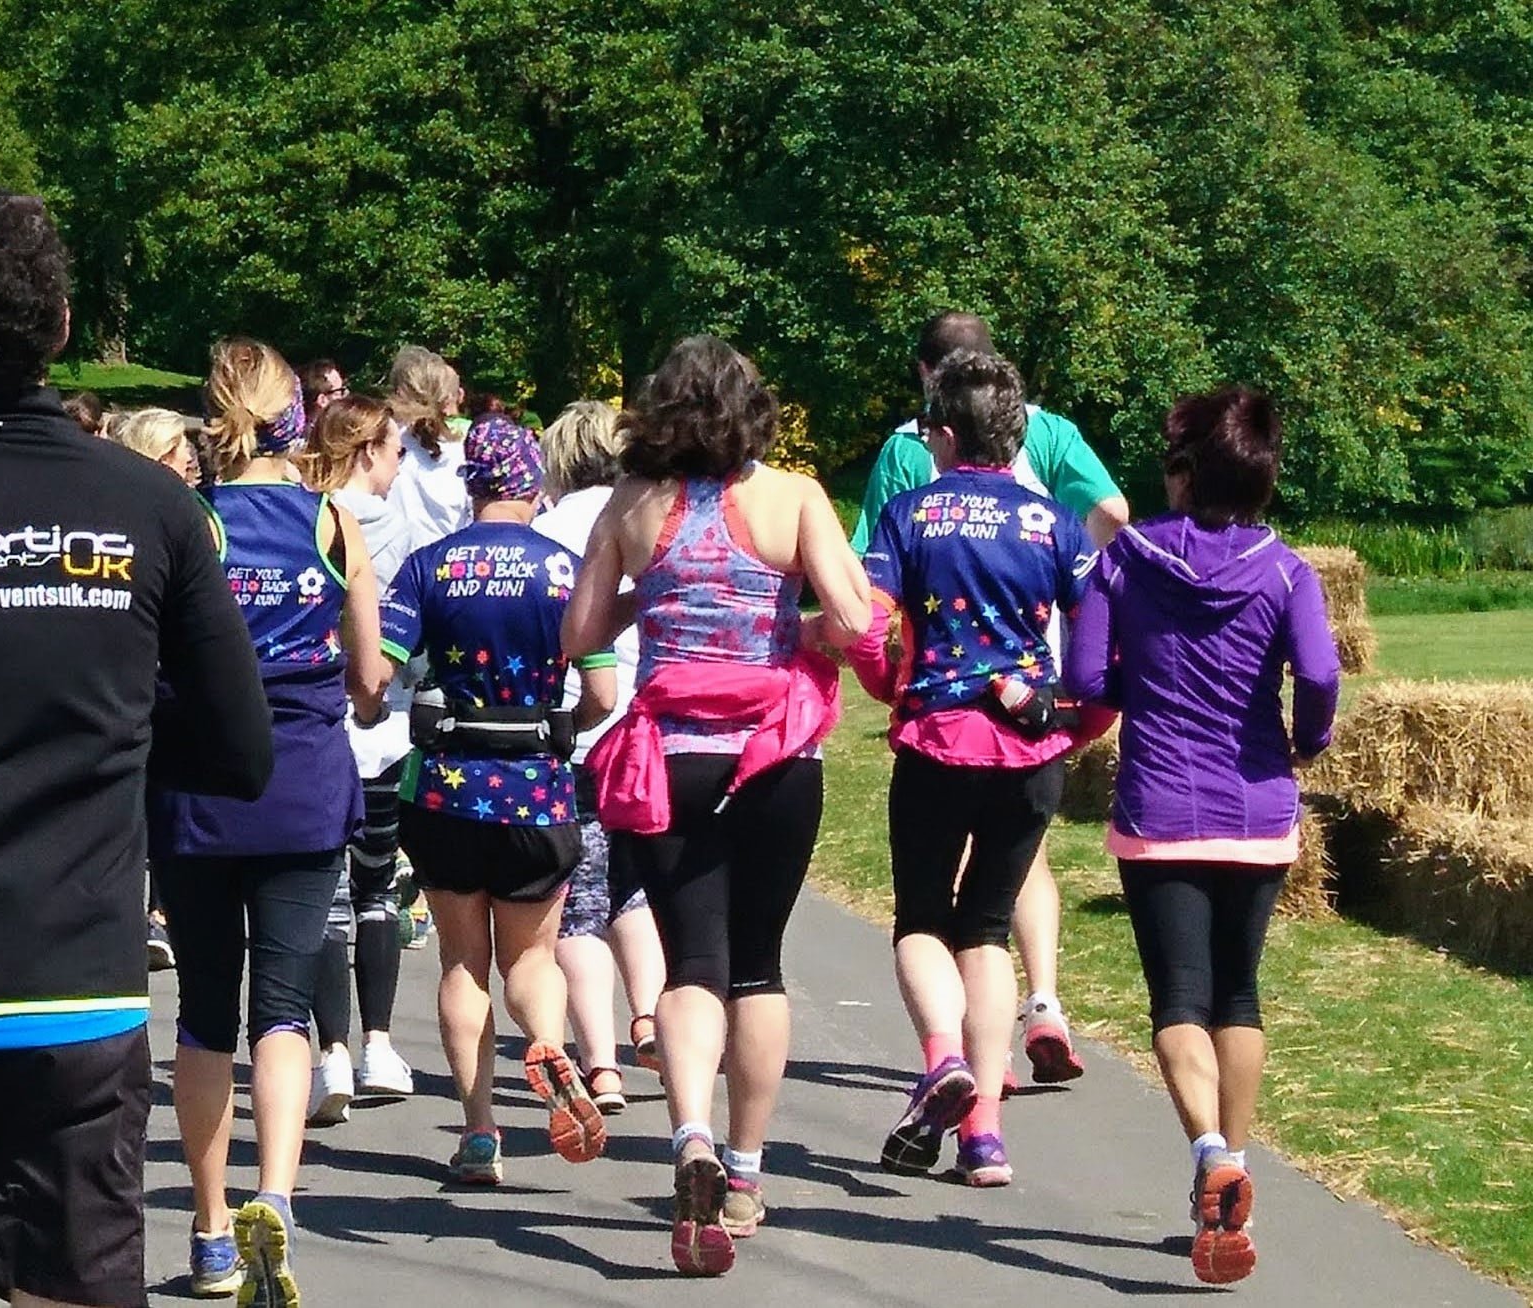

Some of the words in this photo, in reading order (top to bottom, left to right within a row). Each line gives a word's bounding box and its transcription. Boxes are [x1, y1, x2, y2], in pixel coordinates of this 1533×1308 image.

[922, 493, 956, 509] GET
[960, 493, 999, 510] YOUR
[913, 506, 966, 523] MOJO
[969, 508, 1012, 525] BACK
[923, 522, 956, 538] AND
[959, 522, 999, 540] RUN!
[445, 545, 481, 562] GET
[485, 545, 526, 562] YOUR
[62, 553, 133, 581] UK
[228, 566, 253, 580] GET
[255, 568, 284, 581] YOUR
[436, 560, 492, 582] MOJO
[494, 562, 539, 579] BACK
[231, 580, 260, 593] OJO
[261, 580, 293, 593] BACK
[446, 580, 481, 597] AND
[485, 580, 526, 598] RUN!
[254, 594, 285, 606] RUN!
